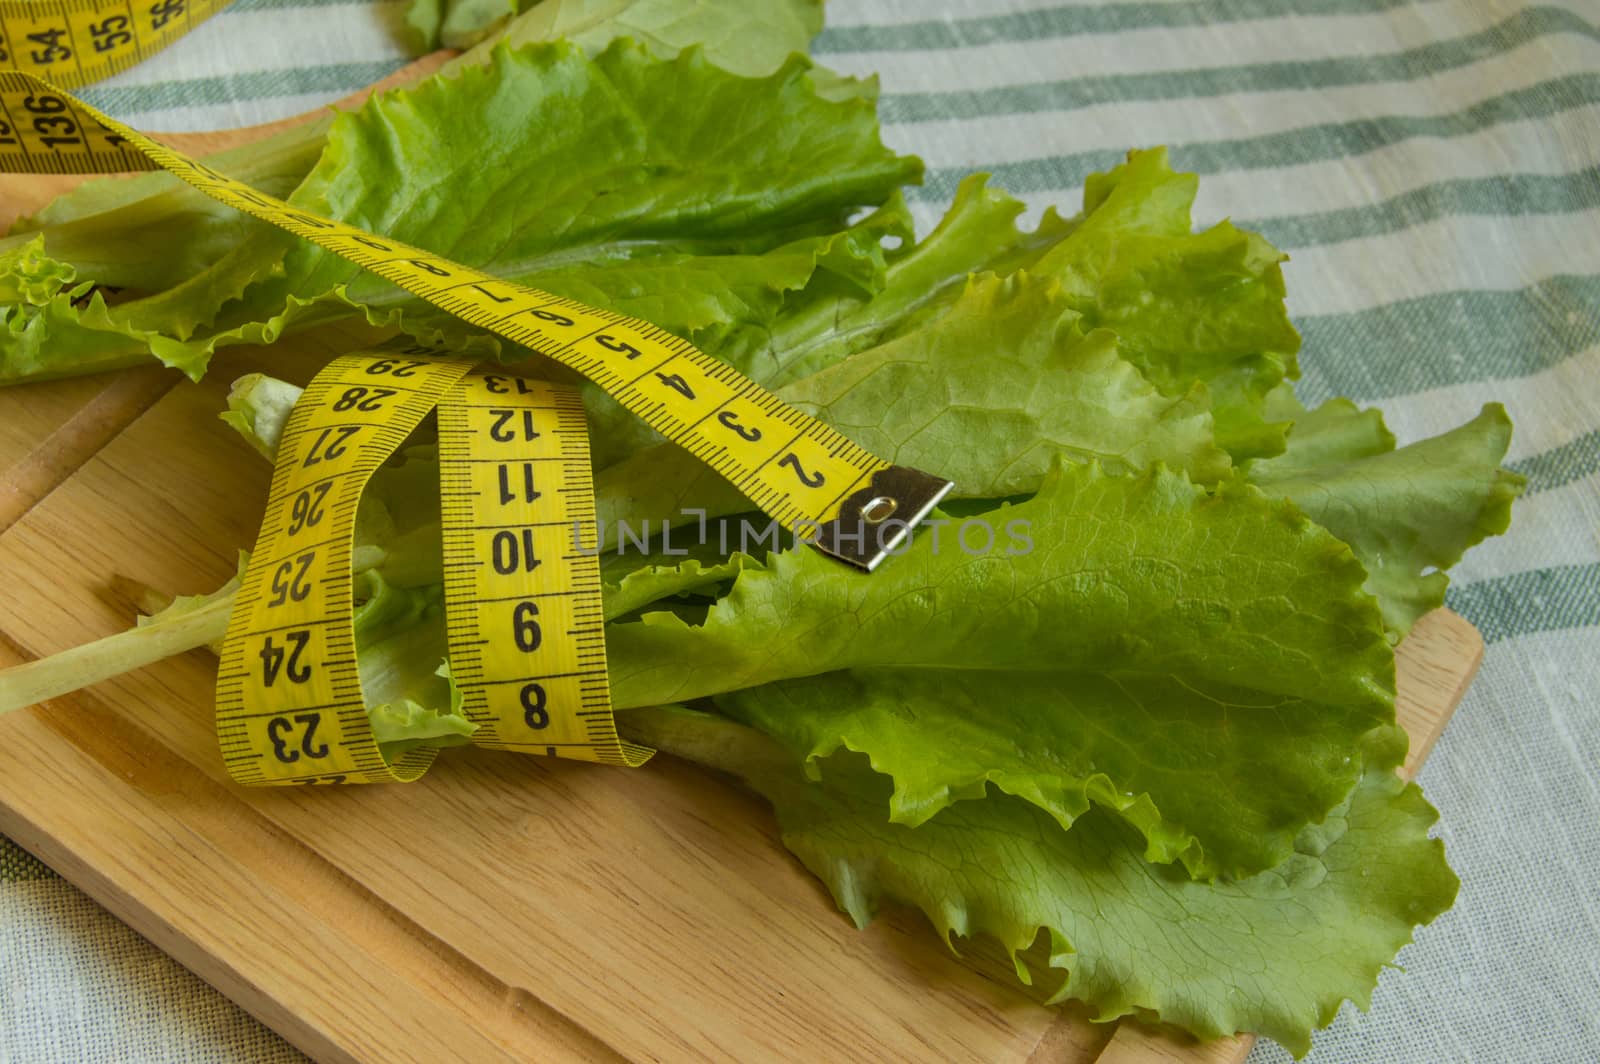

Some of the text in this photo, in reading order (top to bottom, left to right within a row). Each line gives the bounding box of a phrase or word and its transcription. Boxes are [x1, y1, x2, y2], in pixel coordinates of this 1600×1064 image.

[149, 0, 184, 31] 56
[27, 28, 72, 65] 54
[89, 15, 132, 53] 55
[24, 95, 80, 149] 136
[410, 260, 450, 277] 8
[472, 284, 513, 303] 7
[530, 310, 575, 327] 6
[595, 334, 642, 361] 5
[366, 359, 431, 377] 29
[483, 375, 534, 395] 13
[655, 371, 696, 400] 4
[332, 387, 397, 412] 28
[489, 409, 540, 443] 12
[717, 411, 762, 442] 3
[302, 426, 361, 468] 27
[498, 463, 541, 506] 11
[778, 452, 825, 488] 2
[288, 481, 333, 536] 26
[492, 528, 542, 575] 10
[267, 551, 315, 609] 25
[513, 601, 542, 653] 9
[260, 630, 311, 688] 24
[519, 683, 550, 730] 8
[267, 713, 329, 763] 23
